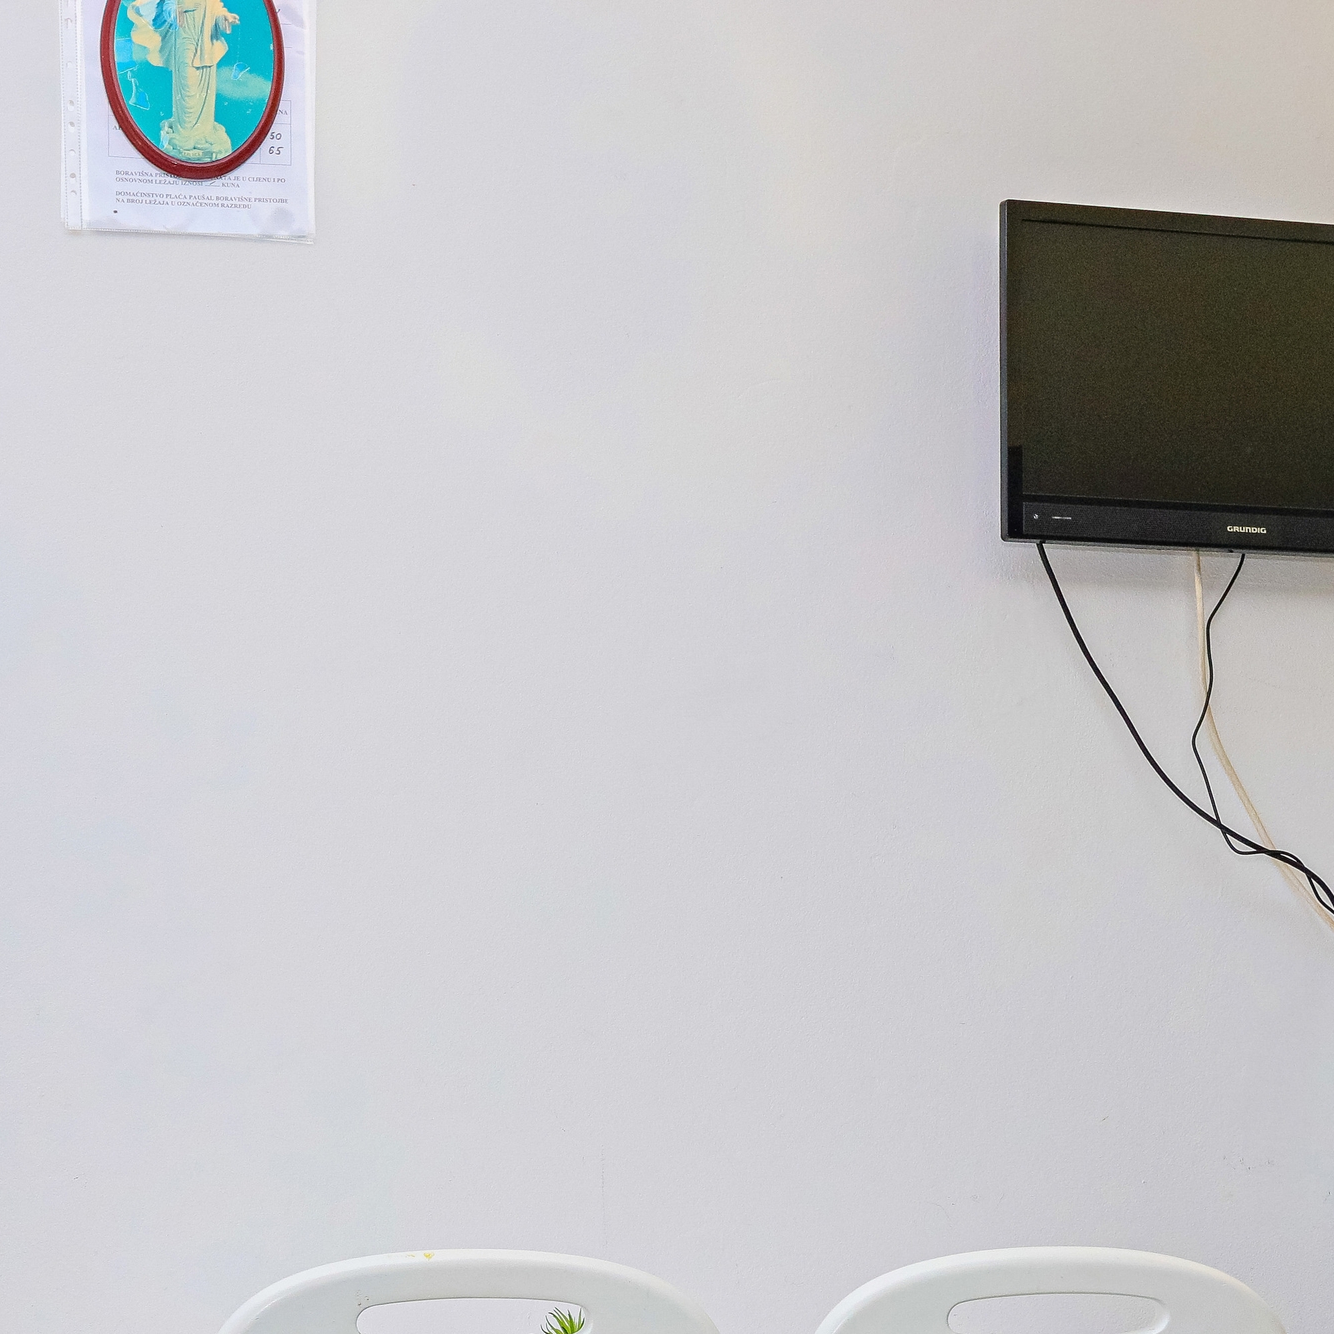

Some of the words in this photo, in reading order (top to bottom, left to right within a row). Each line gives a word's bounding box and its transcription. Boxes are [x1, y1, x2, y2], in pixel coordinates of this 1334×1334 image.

[269, 131, 282, 140] 50
[268, 146, 284, 155] 65
[115, 170, 153, 178] BORAVIŠNA
[115, 176, 154, 184] OSNOVNOM
[1226, 525, 1267, 534] GRUNDIG
